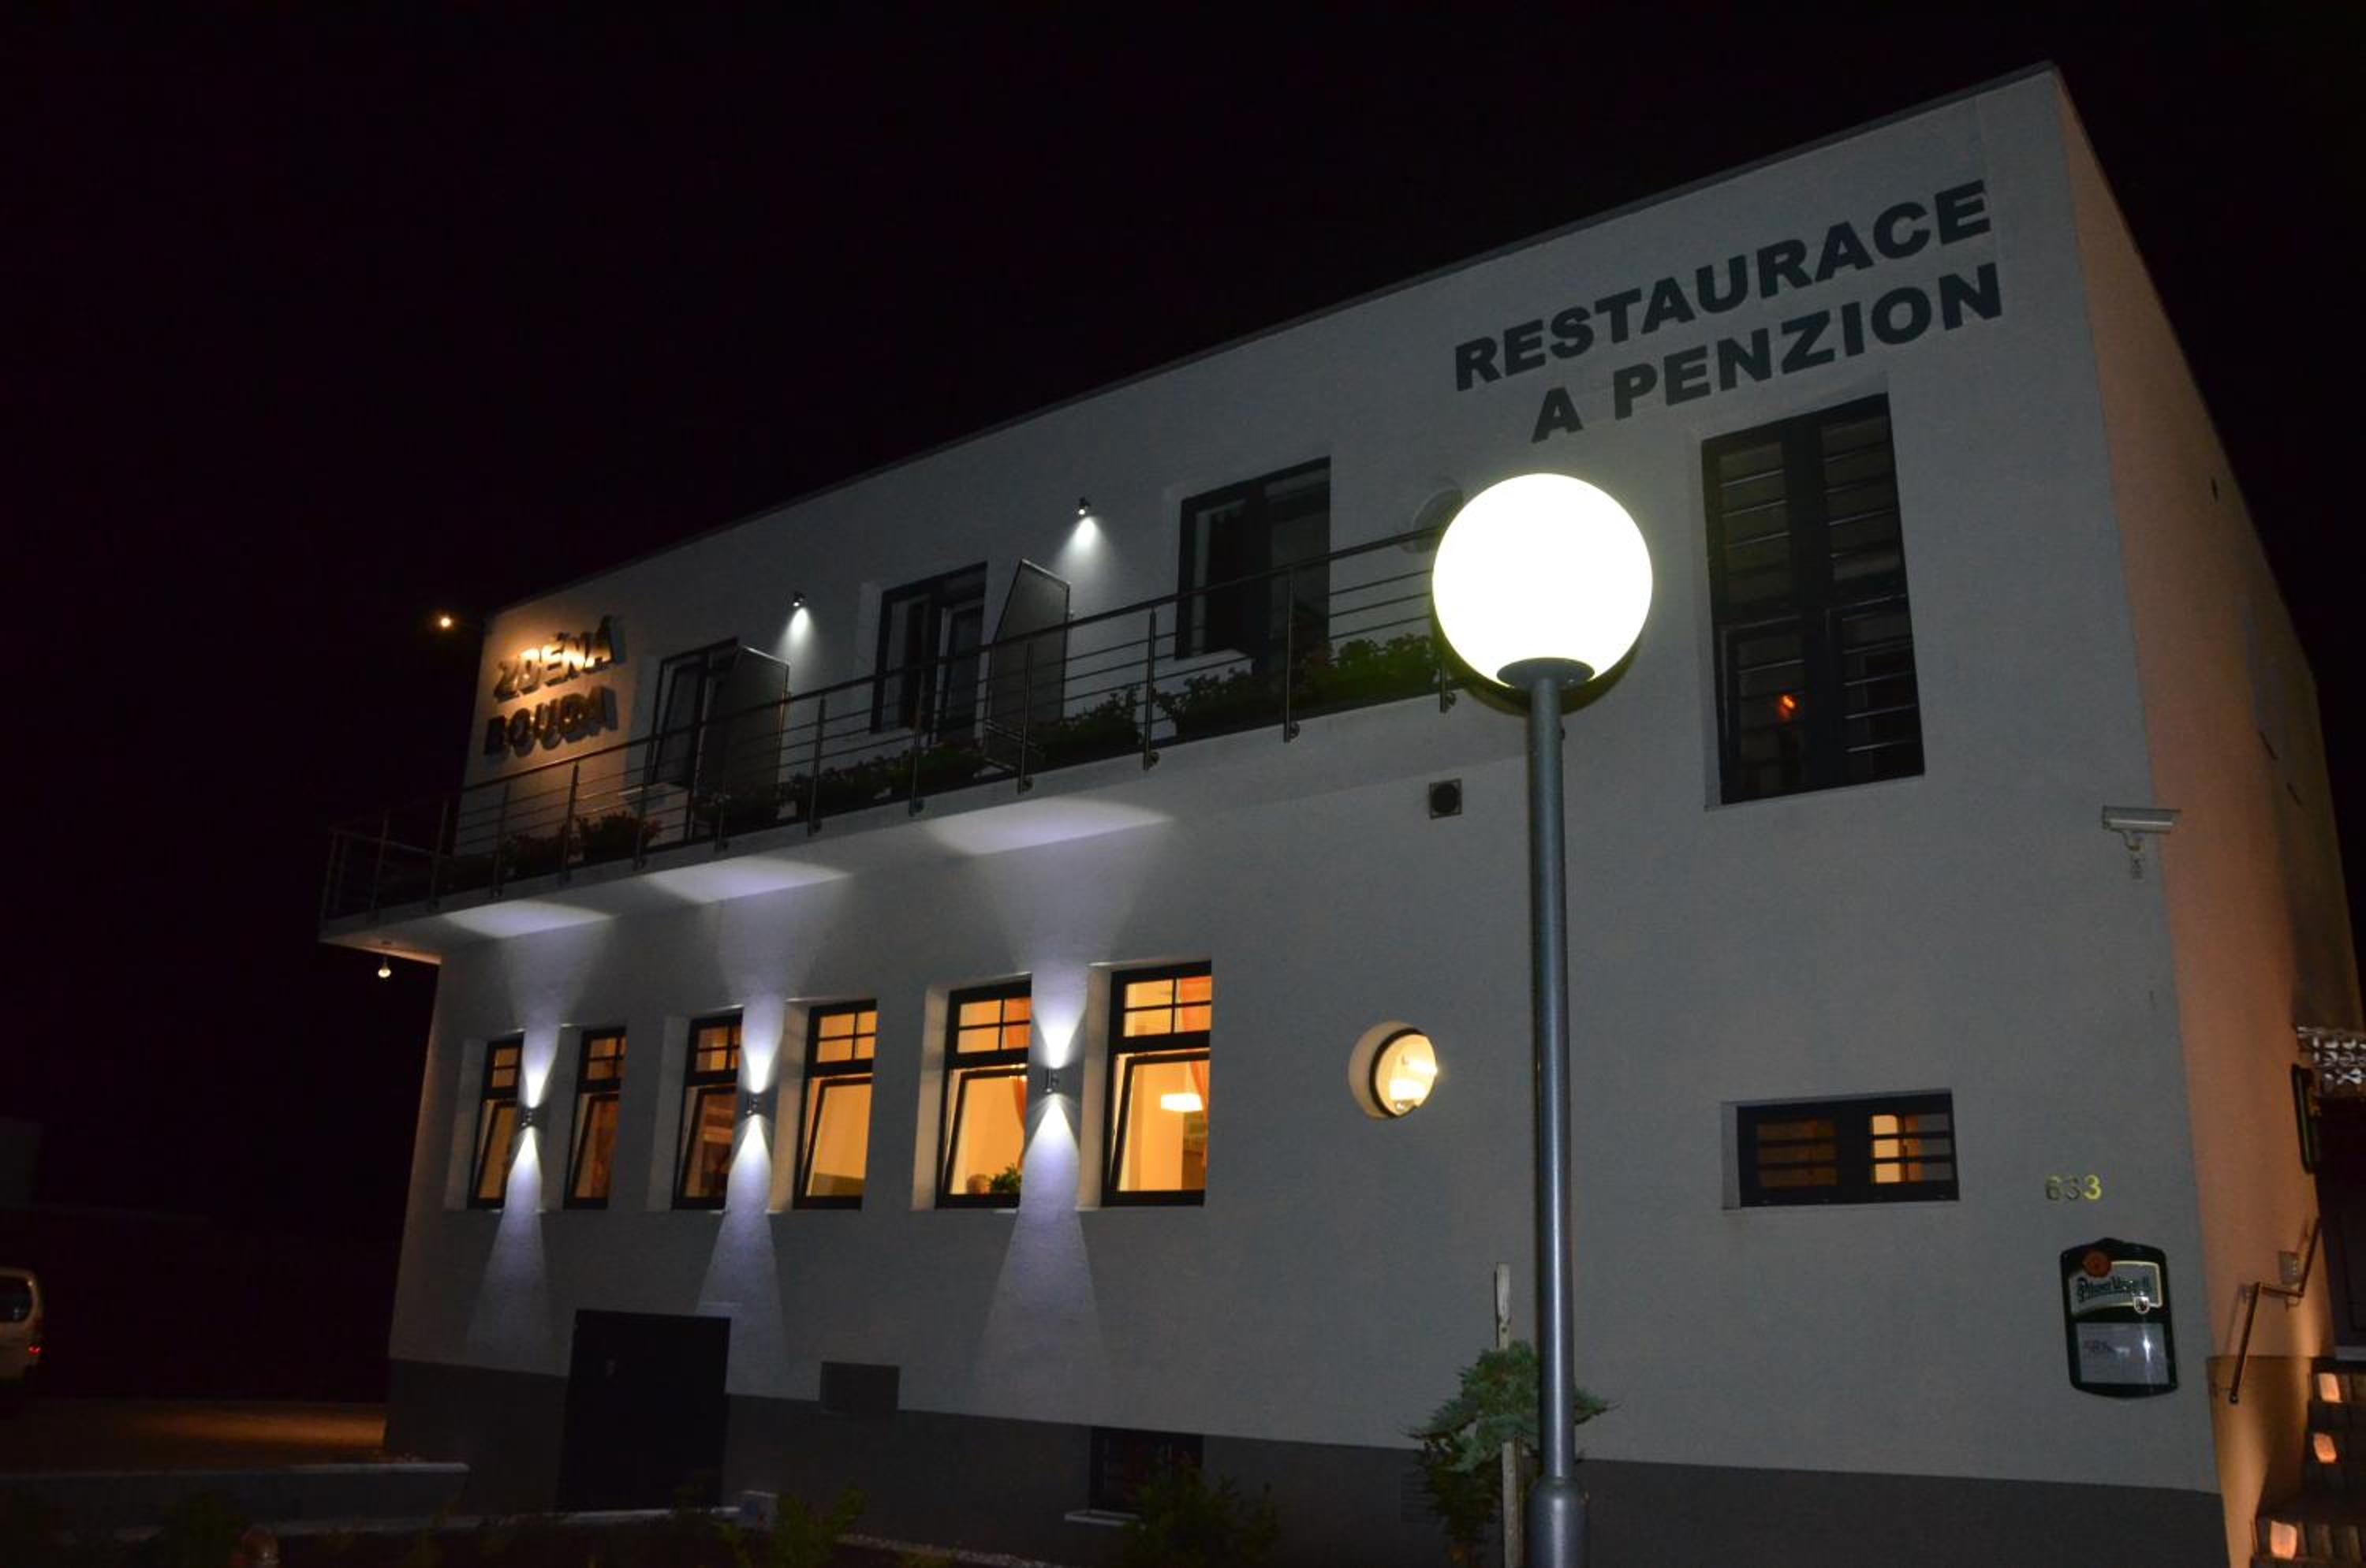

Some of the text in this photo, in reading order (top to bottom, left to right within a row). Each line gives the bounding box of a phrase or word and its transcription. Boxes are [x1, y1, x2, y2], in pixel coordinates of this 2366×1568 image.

[1454, 179, 1992, 391] RESTAURACE
[1531, 262, 2003, 443] A PENZION
[2045, 1174, 2103, 1200] 633
